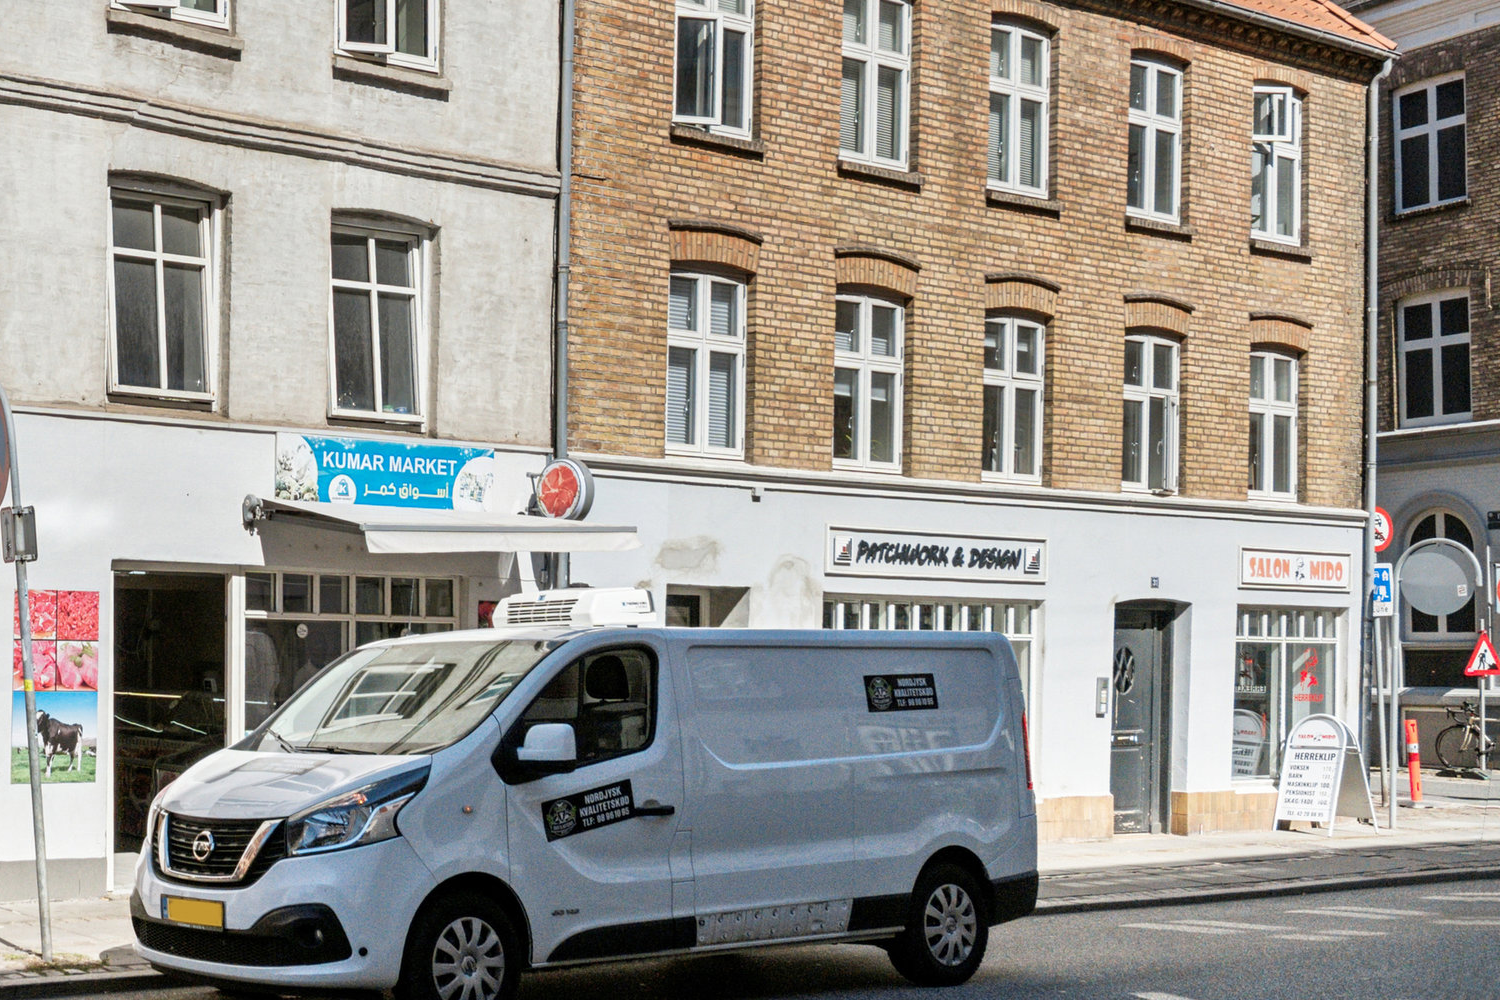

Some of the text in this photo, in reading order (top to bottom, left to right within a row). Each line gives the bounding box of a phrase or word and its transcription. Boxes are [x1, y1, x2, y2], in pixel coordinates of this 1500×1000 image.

[323, 450, 458, 477] KUMAR MARKET
[363, 482, 396, 496] كمر
[855, 539, 1022, 570] PATCHWORK & DESIGN
[1249, 557, 1343, 582] SALON MIDO
[1294, 752, 1337, 761] HERREKLIP
[584, 786, 622, 805] NORDJYSK
